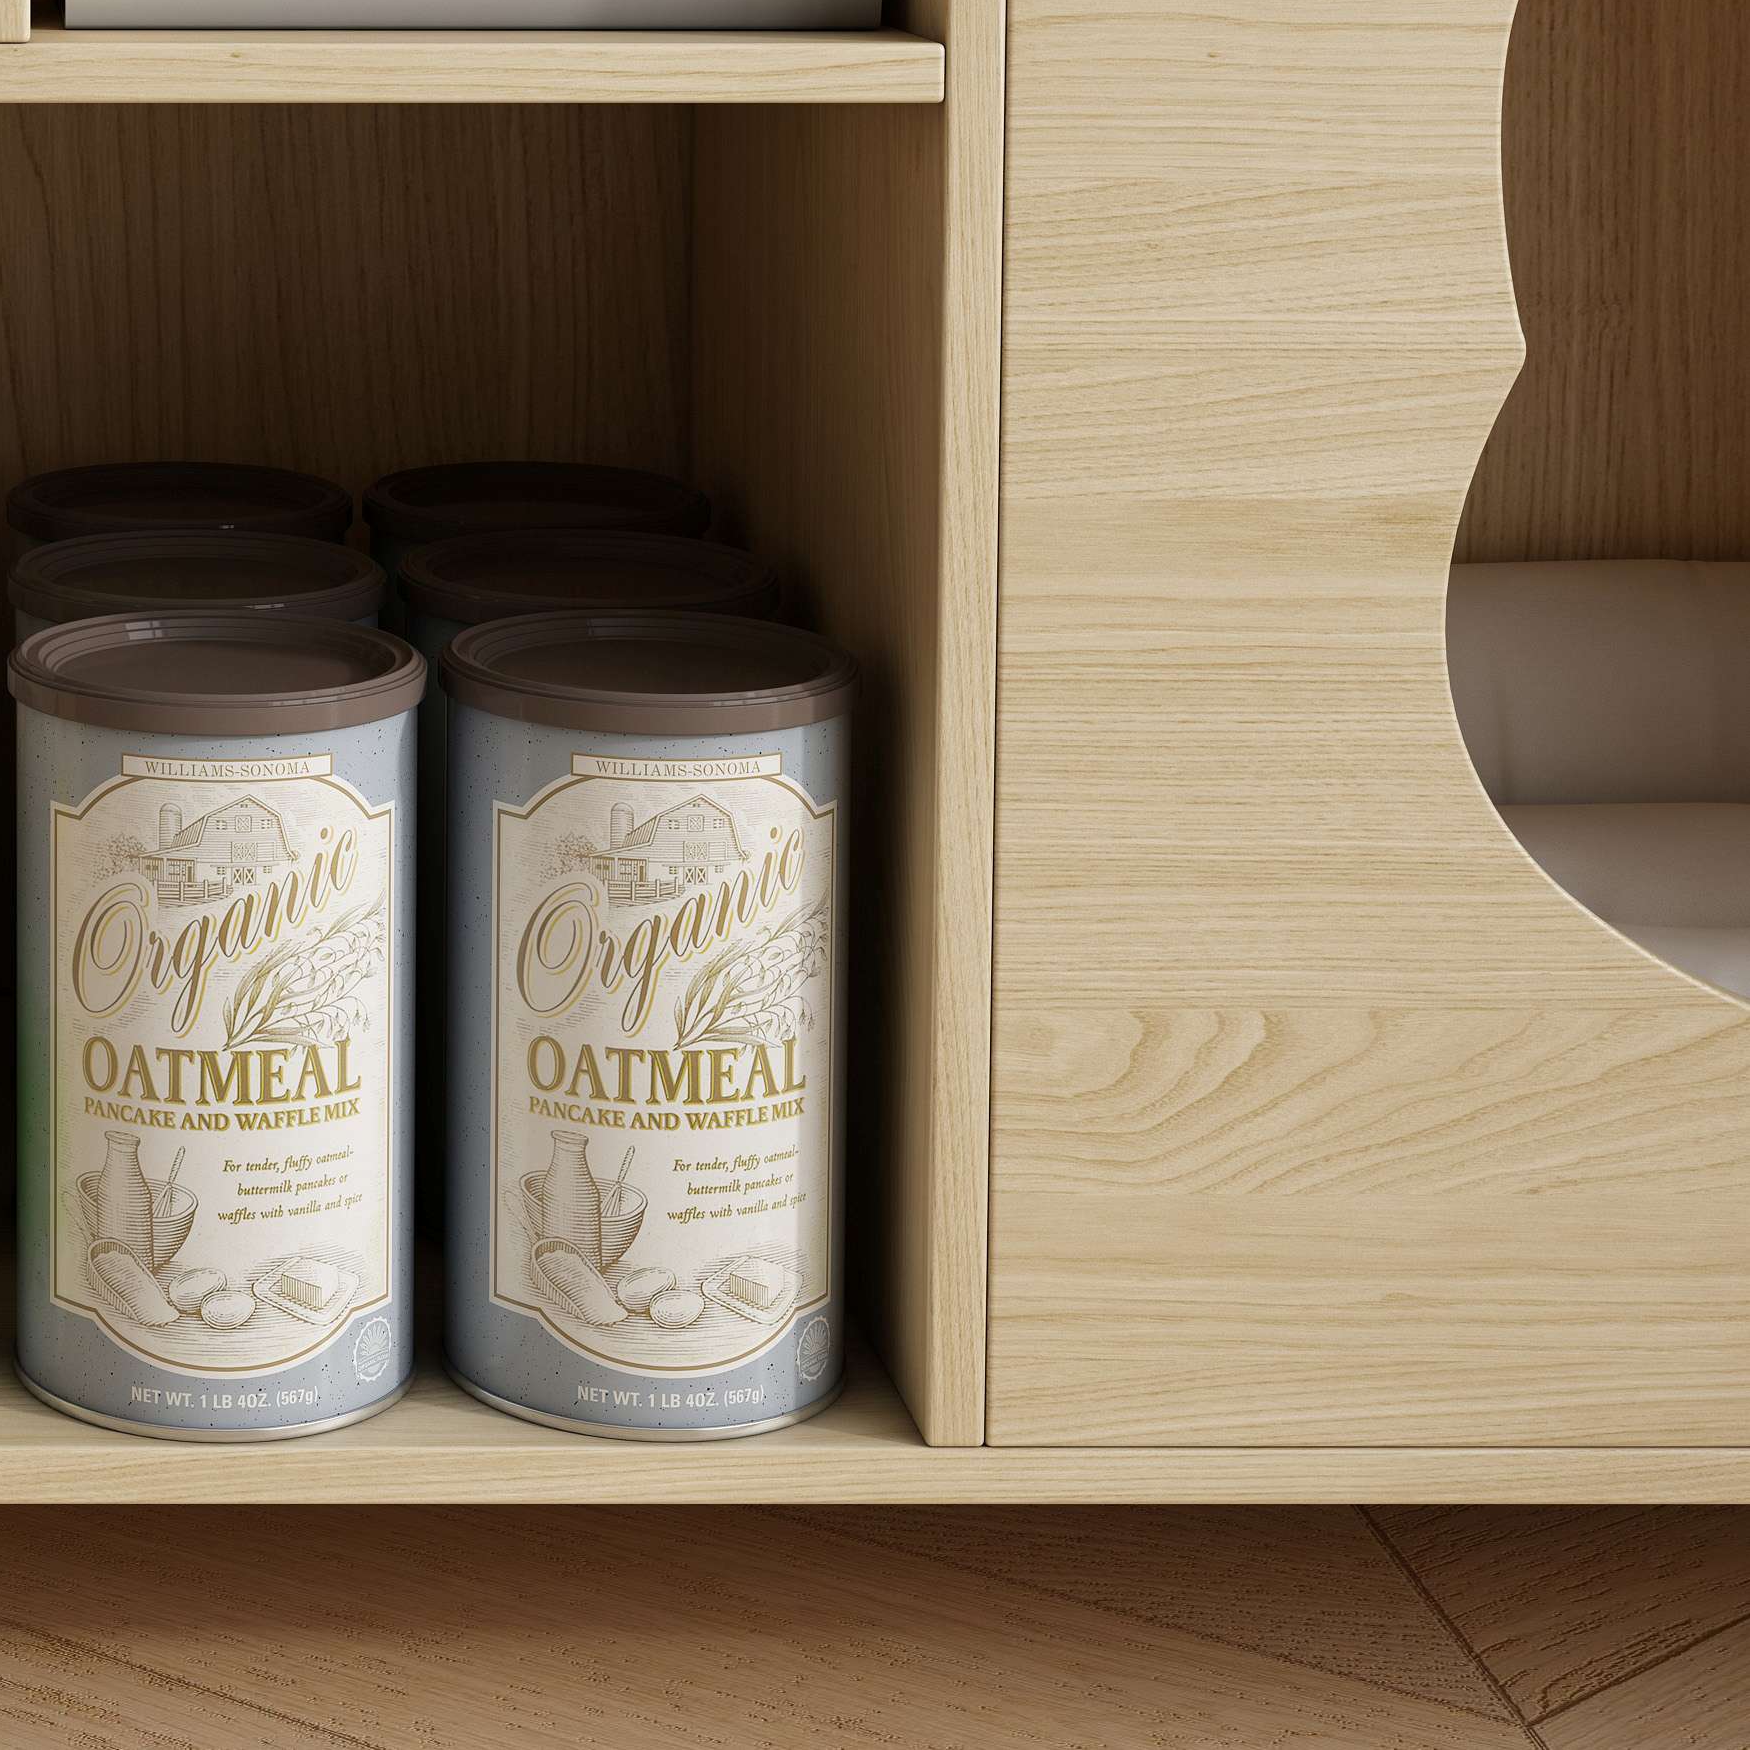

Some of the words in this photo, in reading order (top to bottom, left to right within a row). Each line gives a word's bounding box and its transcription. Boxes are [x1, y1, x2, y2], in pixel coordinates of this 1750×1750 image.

[144, 758, 311, 779] WILLIAMS-SONOMA
[595, 758, 762, 779] WILLIAMS-SONOMA
[71, 823, 359, 1038] Organic
[517, 823, 806, 1038] Organic
[81, 1034, 362, 1108] OATMEAL
[526, 1035, 808, 1107] OATMEAL
[83, 1095, 178, 1131] PANCAKE
[180, 1108, 228, 1132] AND
[234, 1106, 321, 1132] WAFFLE
[323, 1097, 362, 1122] MIX
[528, 1094, 626, 1131] PANCAKE
[628, 1109, 680, 1132] AND
[684, 1105, 768, 1131] WAFFLE
[772, 1096, 806, 1122] MIX
[222, 1159, 241, 1173] For
[246, 1157, 281, 1174] tender,
[281, 1155, 313, 1174] fluffy
[316, 1145, 355, 1165] oatmeal-
[672, 1158, 692, 1172] For
[696, 1156, 729, 1173] tender,
[730, 1154, 761, 1173] fluffy
[763, 1144, 800, 1164] oatmeal-
[237, 1179, 293, 1197] buttermilk
[295, 1173, 336, 1196] pancakes
[339, 1173, 348, 1184] or
[687, 1178, 742, 1196] buttermilk
[743, 1173, 783, 1196] pancakes
[785, 1172, 794, 1183] or
[217, 1207, 256, 1225] waffles
[260, 1204, 284, 1219] with
[288, 1200, 321, 1217] vanilla
[324, 1195, 342, 1211] and
[344, 1193, 363, 1210] spice
[666, 1206, 706, 1225] waffles
[709, 1203, 733, 1219] with
[736, 1199, 769, 1217] vanilla
[771, 1194, 787, 1210] and
[790, 1192, 807, 1210] spice
[131, 1385, 159, 1405] NET
[161, 1386, 195, 1408] WT.
[199, 1387, 206, 1408] 1
[211, 1387, 232, 1408] LB
[275, 1382, 319, 1412] (567g)
[576, 1383, 608, 1404] NET
[610, 1385, 645, 1407] WT.
[648, 1386, 655, 1408] 1
[661, 1387, 683, 1408] LB
[722, 1382, 765, 1411] (567g)
